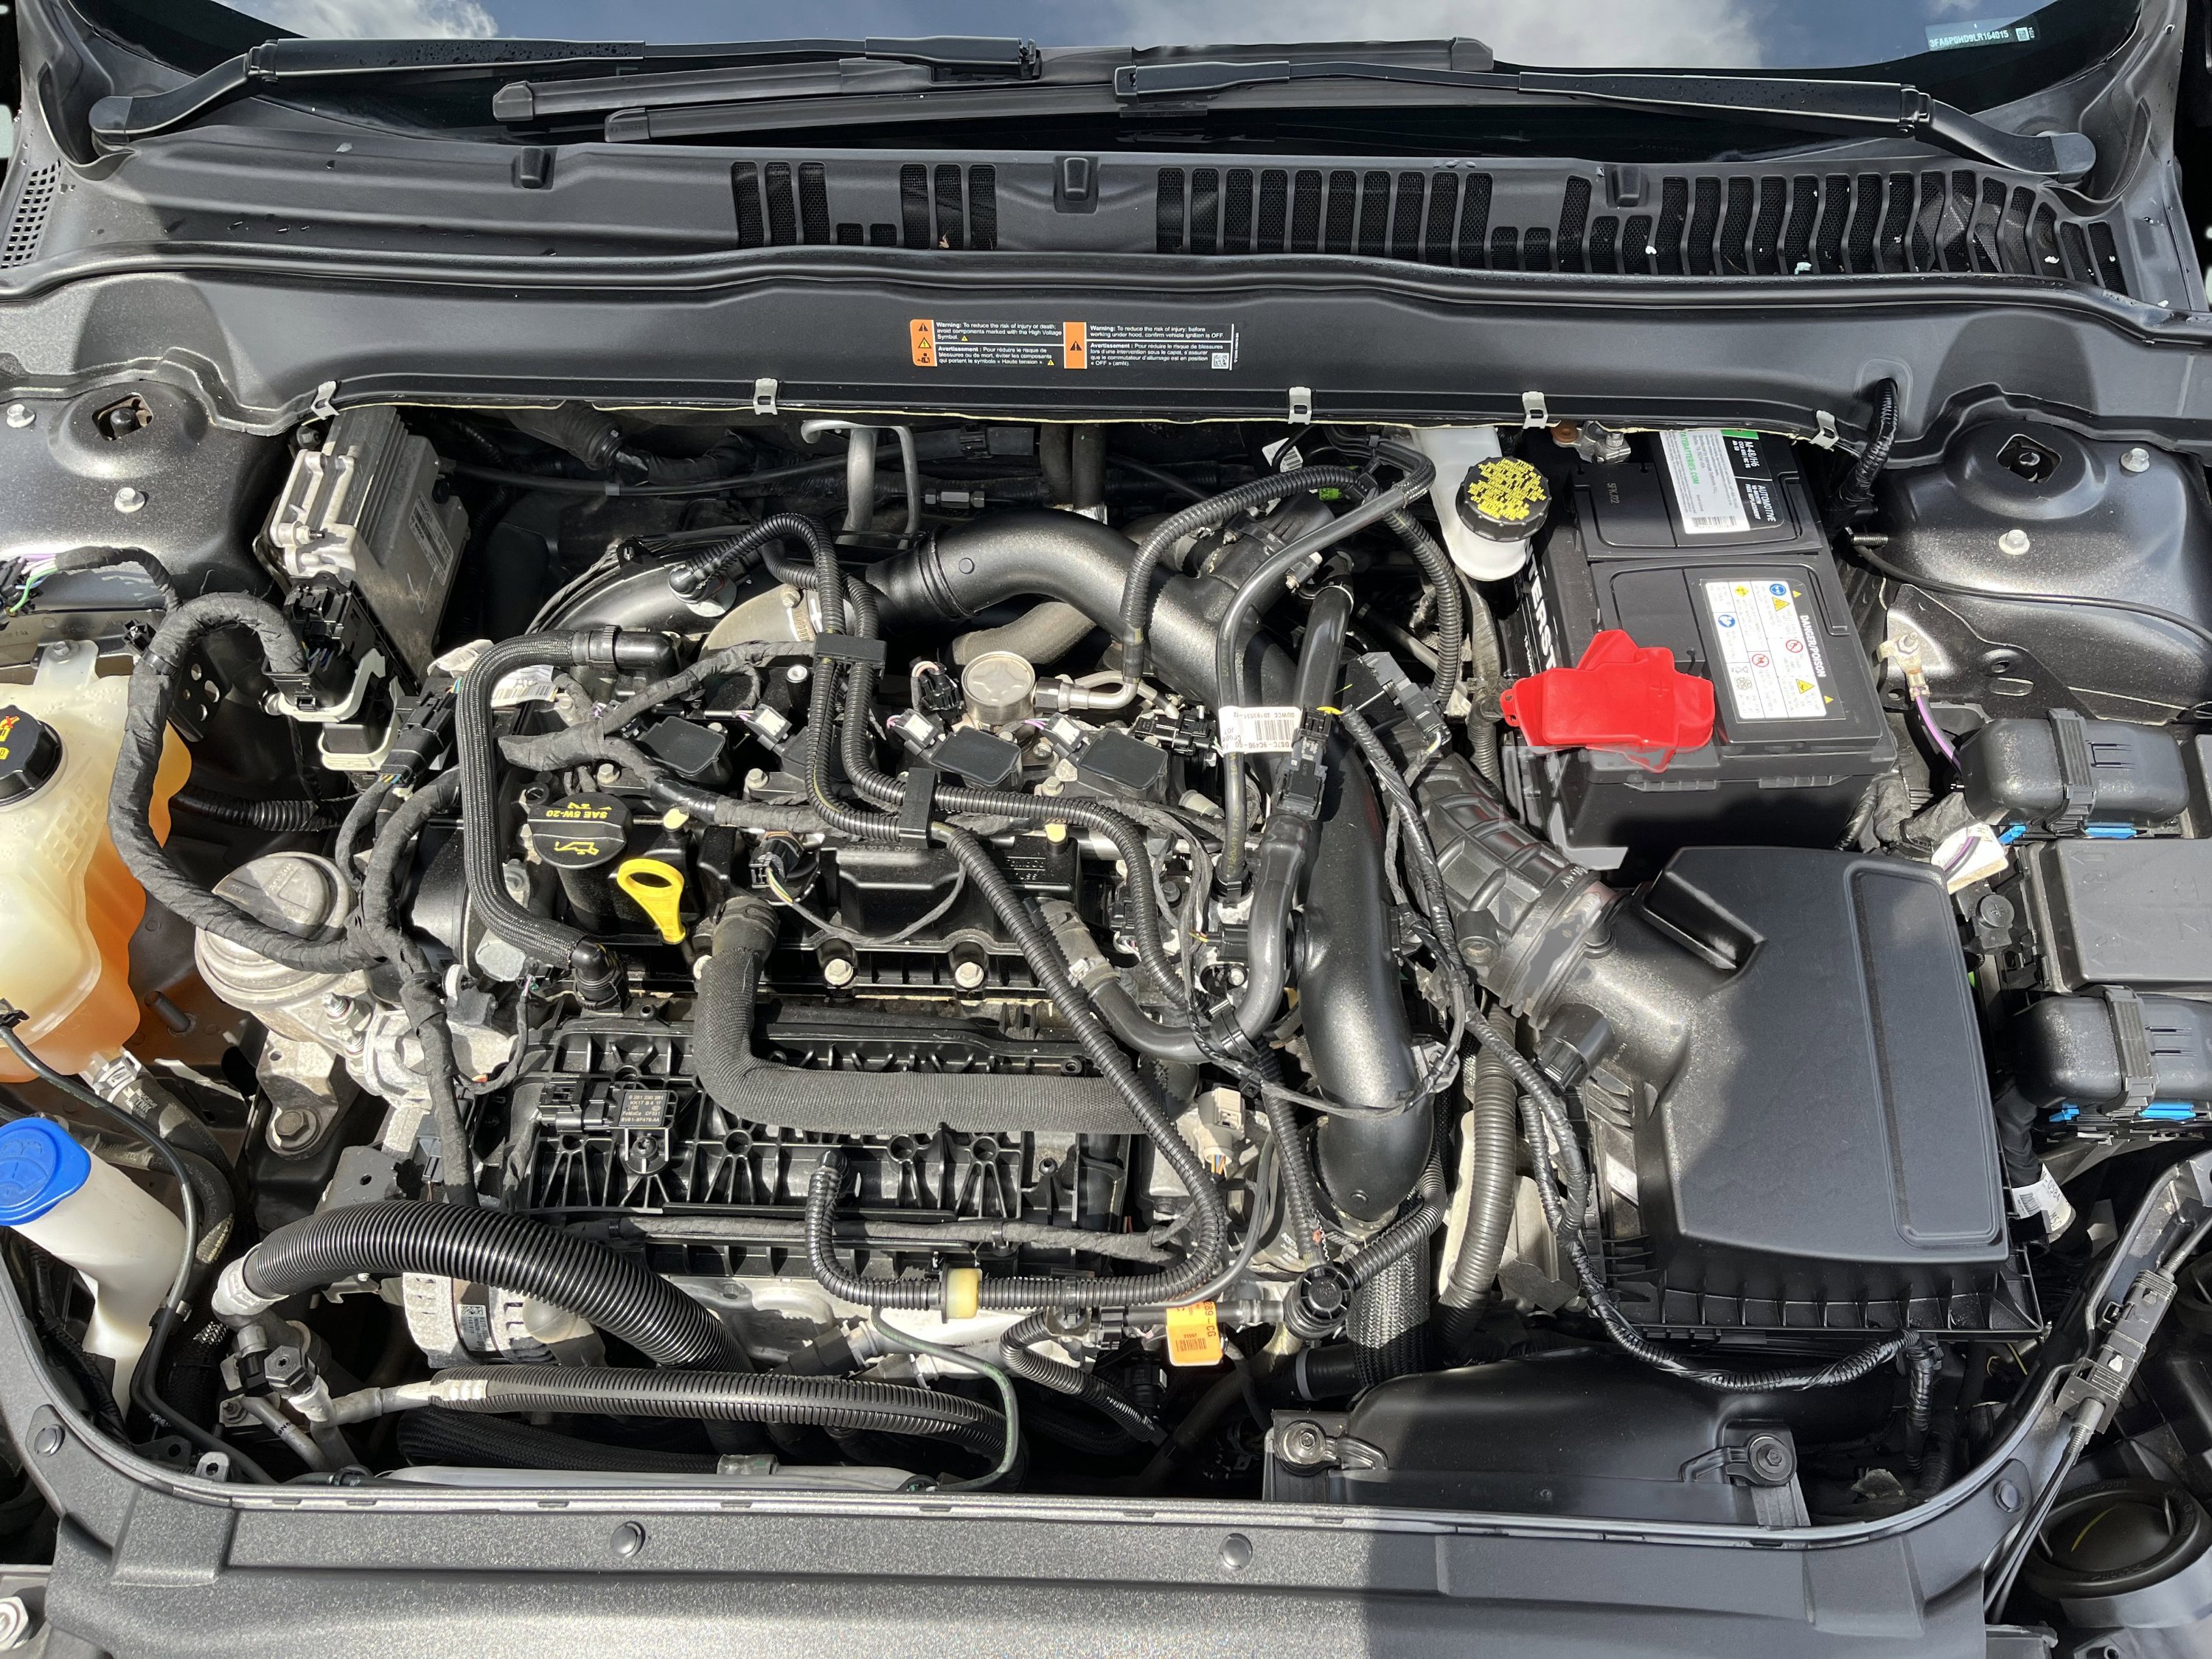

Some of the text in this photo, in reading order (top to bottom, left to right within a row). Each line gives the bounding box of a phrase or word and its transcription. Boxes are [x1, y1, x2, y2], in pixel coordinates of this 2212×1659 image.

[1744, 441, 1759, 467] M-48/H6
[1747, 493, 1761, 519] REPLACEMENT
[1757, 484, 1776, 522] AUTOMOTIVE
[1800, 614, 1826, 678] DANGER/POISON
[546, 810, 608, 819] 5W-20 SAE
